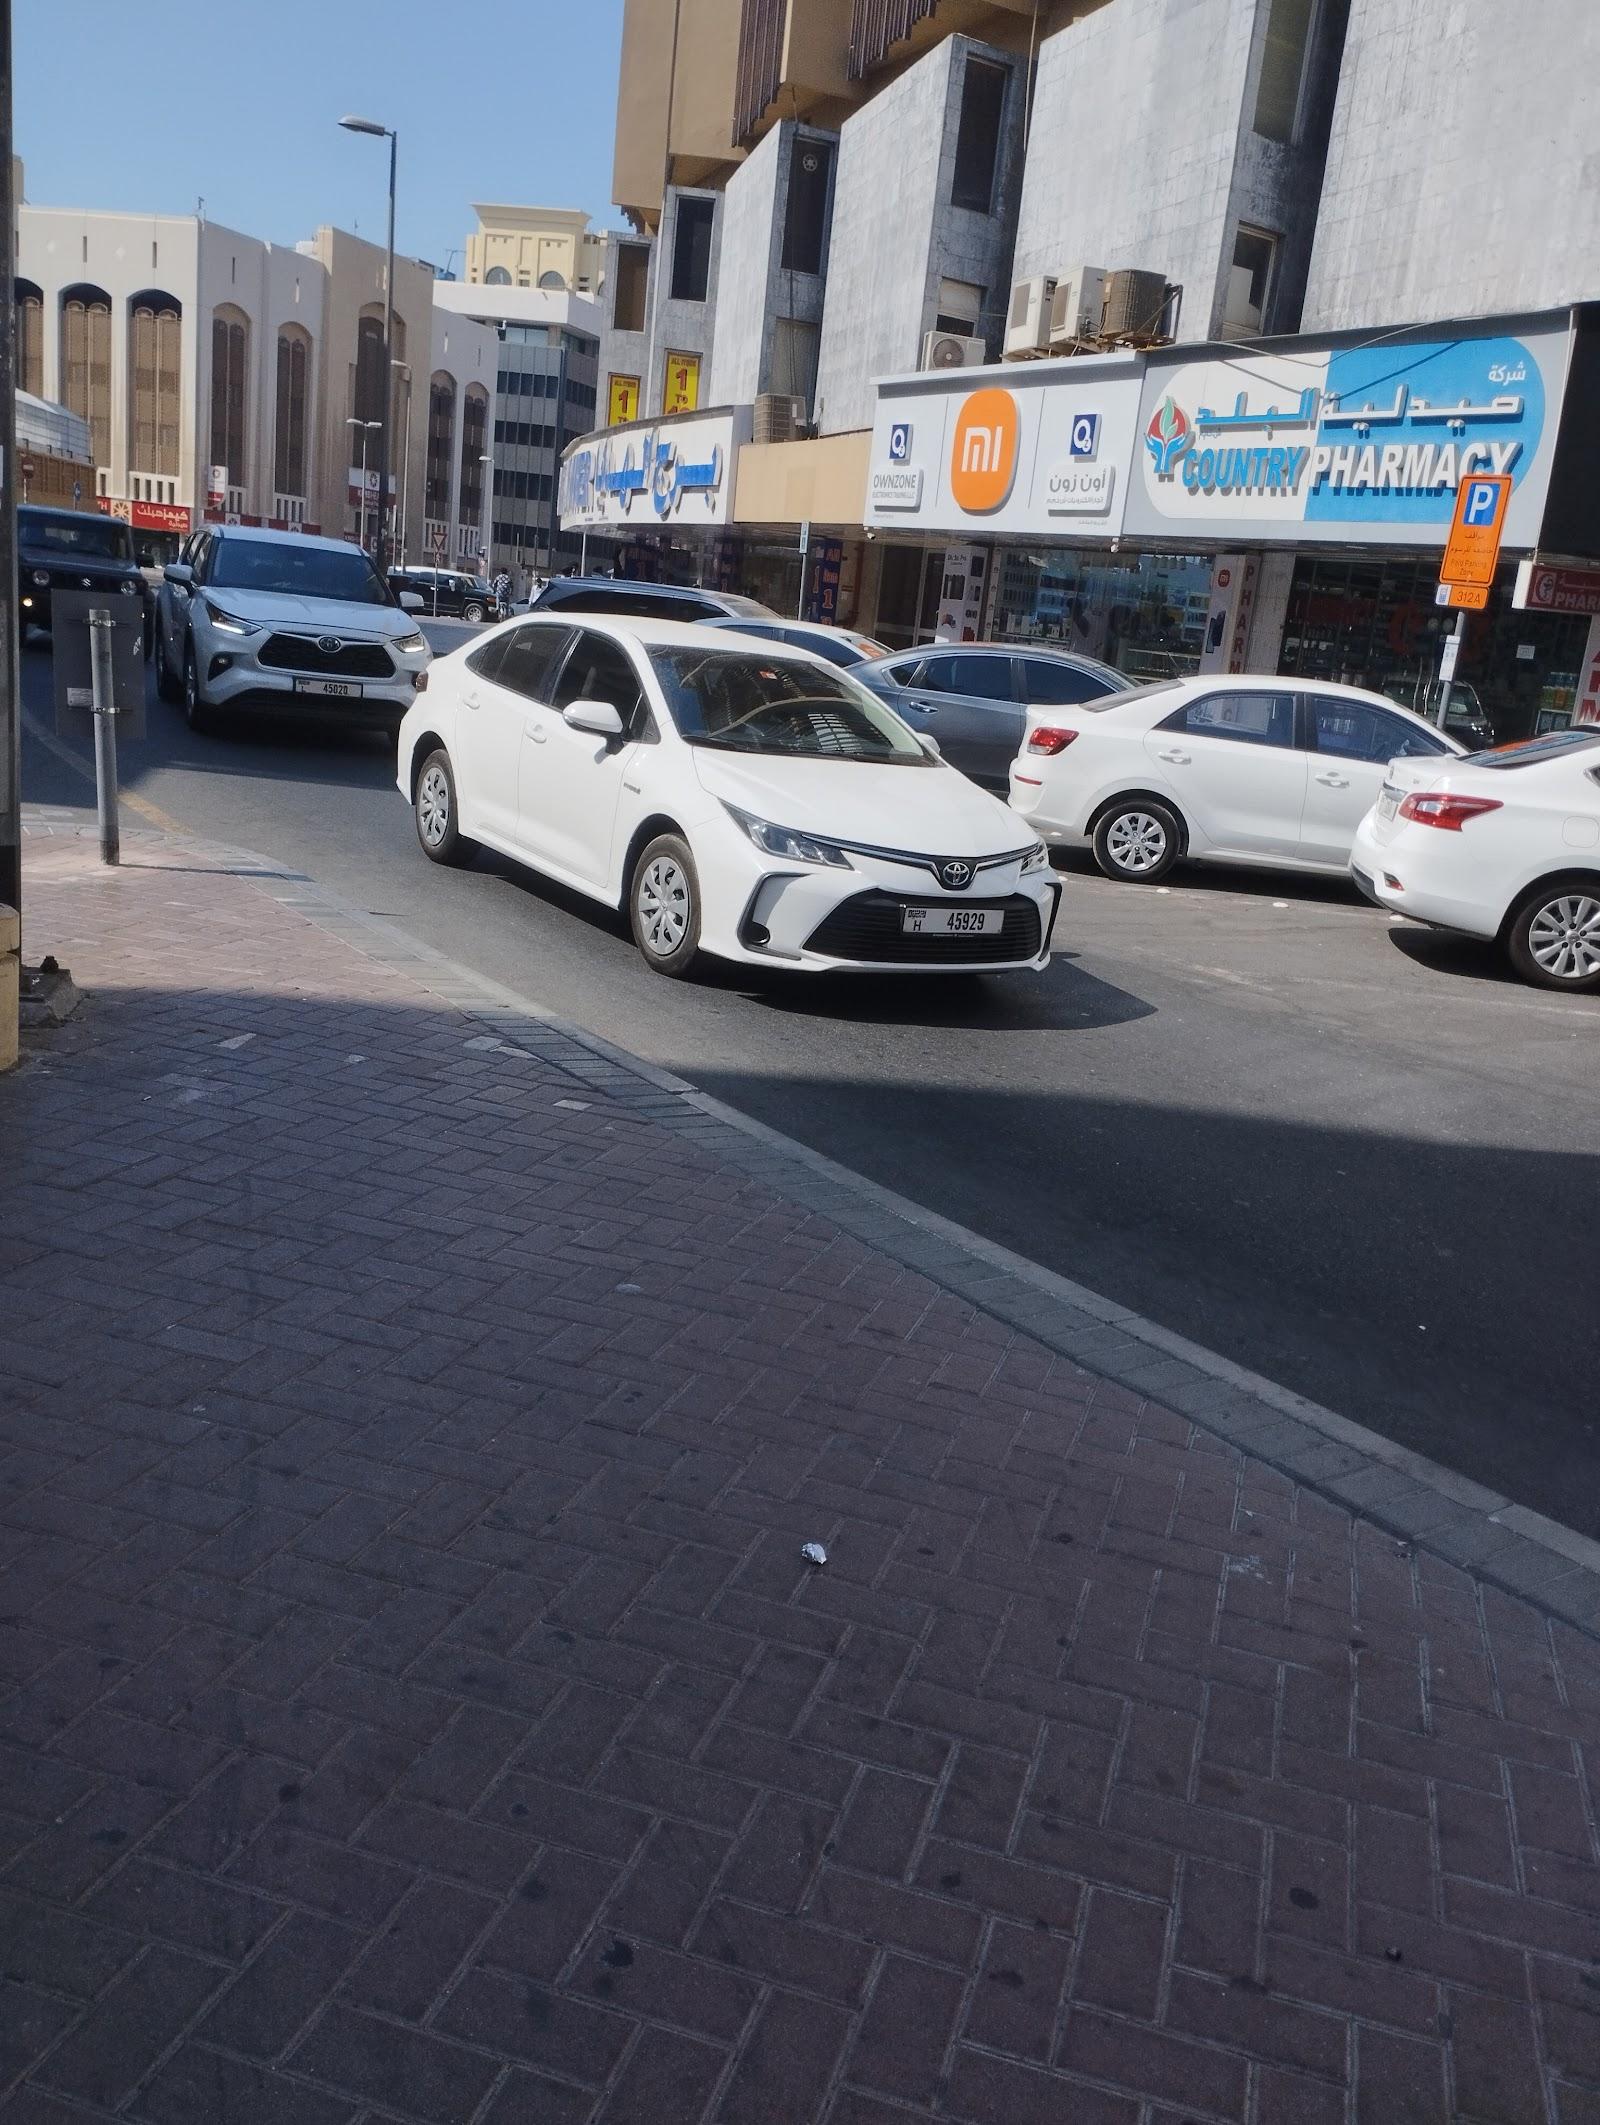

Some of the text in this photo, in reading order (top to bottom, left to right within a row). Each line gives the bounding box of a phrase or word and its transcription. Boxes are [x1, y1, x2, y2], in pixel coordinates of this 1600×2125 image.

[676, 368, 688, 391] 1
[1488, 361, 1526, 384] شركة
[619, 390, 629, 414] 1
[1195, 385, 1524, 433] صيدلية البلد
[1182, 442, 1519, 490] COUNTRY PHARMACY
[873, 474, 917, 489] OWNZONE
[1049, 467, 1107, 493] أون زون
[1468, 484, 1493, 523] P
[822, 588, 834, 609] 1
[1457, 591, 1481, 605] 312A
[1553, 591, 1600, 612] PHAR
[324, 683, 348, 695] 45020
[913, 920, 921, 931] H
[947, 913, 985, 931] 45929
